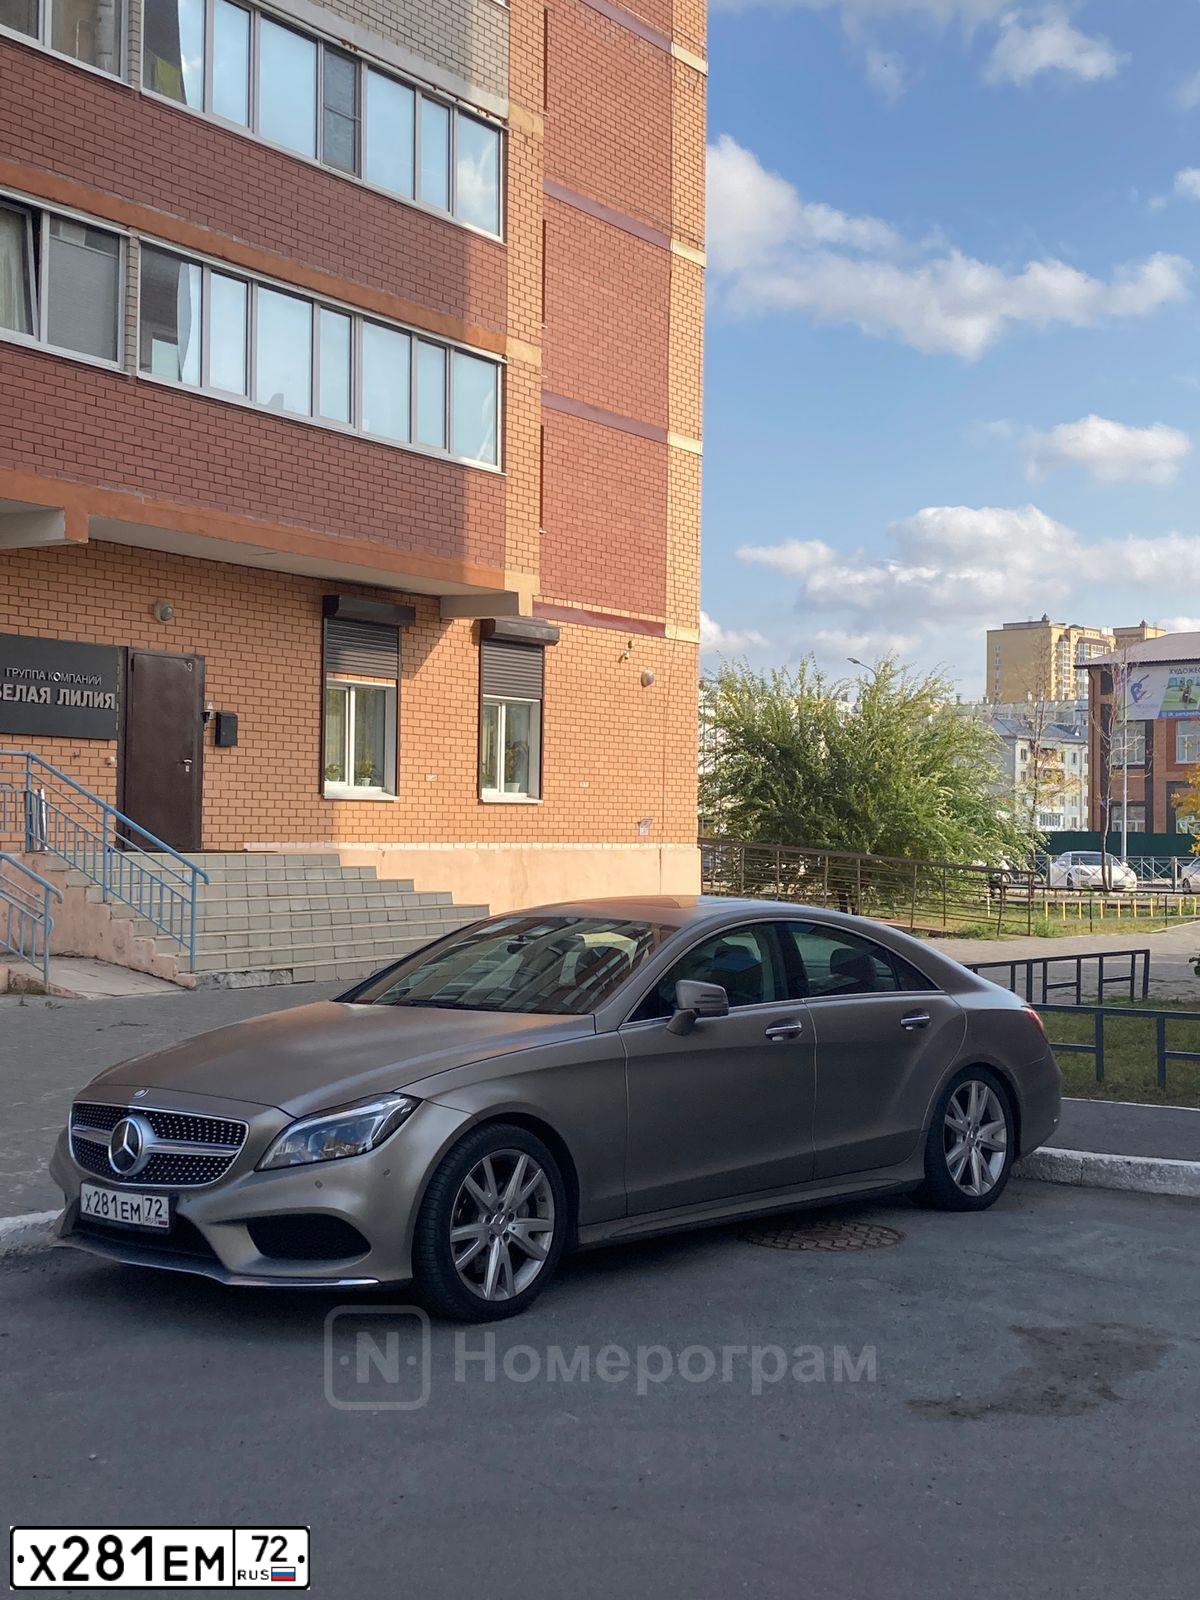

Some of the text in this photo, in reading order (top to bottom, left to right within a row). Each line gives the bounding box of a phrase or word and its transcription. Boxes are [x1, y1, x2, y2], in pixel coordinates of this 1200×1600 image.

[6, 667, 102, 686] ГРУППА КОМПАНИЙ
[0, 683, 116, 710] ЕЛАЯ ЛИЛИЯ
[145, 1197, 163, 1218] 72
